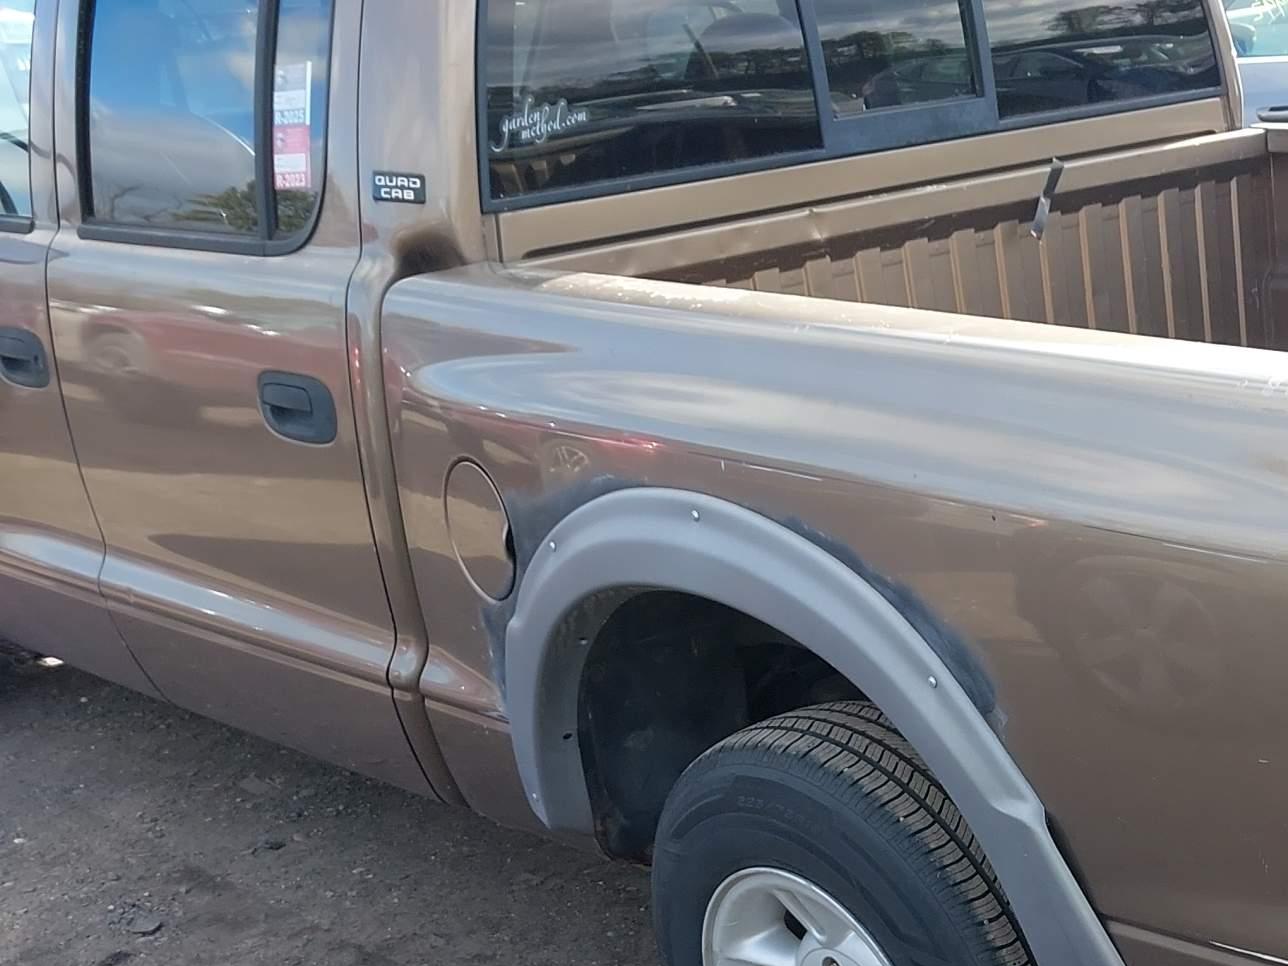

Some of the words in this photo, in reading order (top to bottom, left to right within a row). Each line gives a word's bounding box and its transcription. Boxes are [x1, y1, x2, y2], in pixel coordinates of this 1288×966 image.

[490, 96, 541, 152] garden
[374, 175, 421, 188] QUAD
[380, 187, 415, 200] CAB
